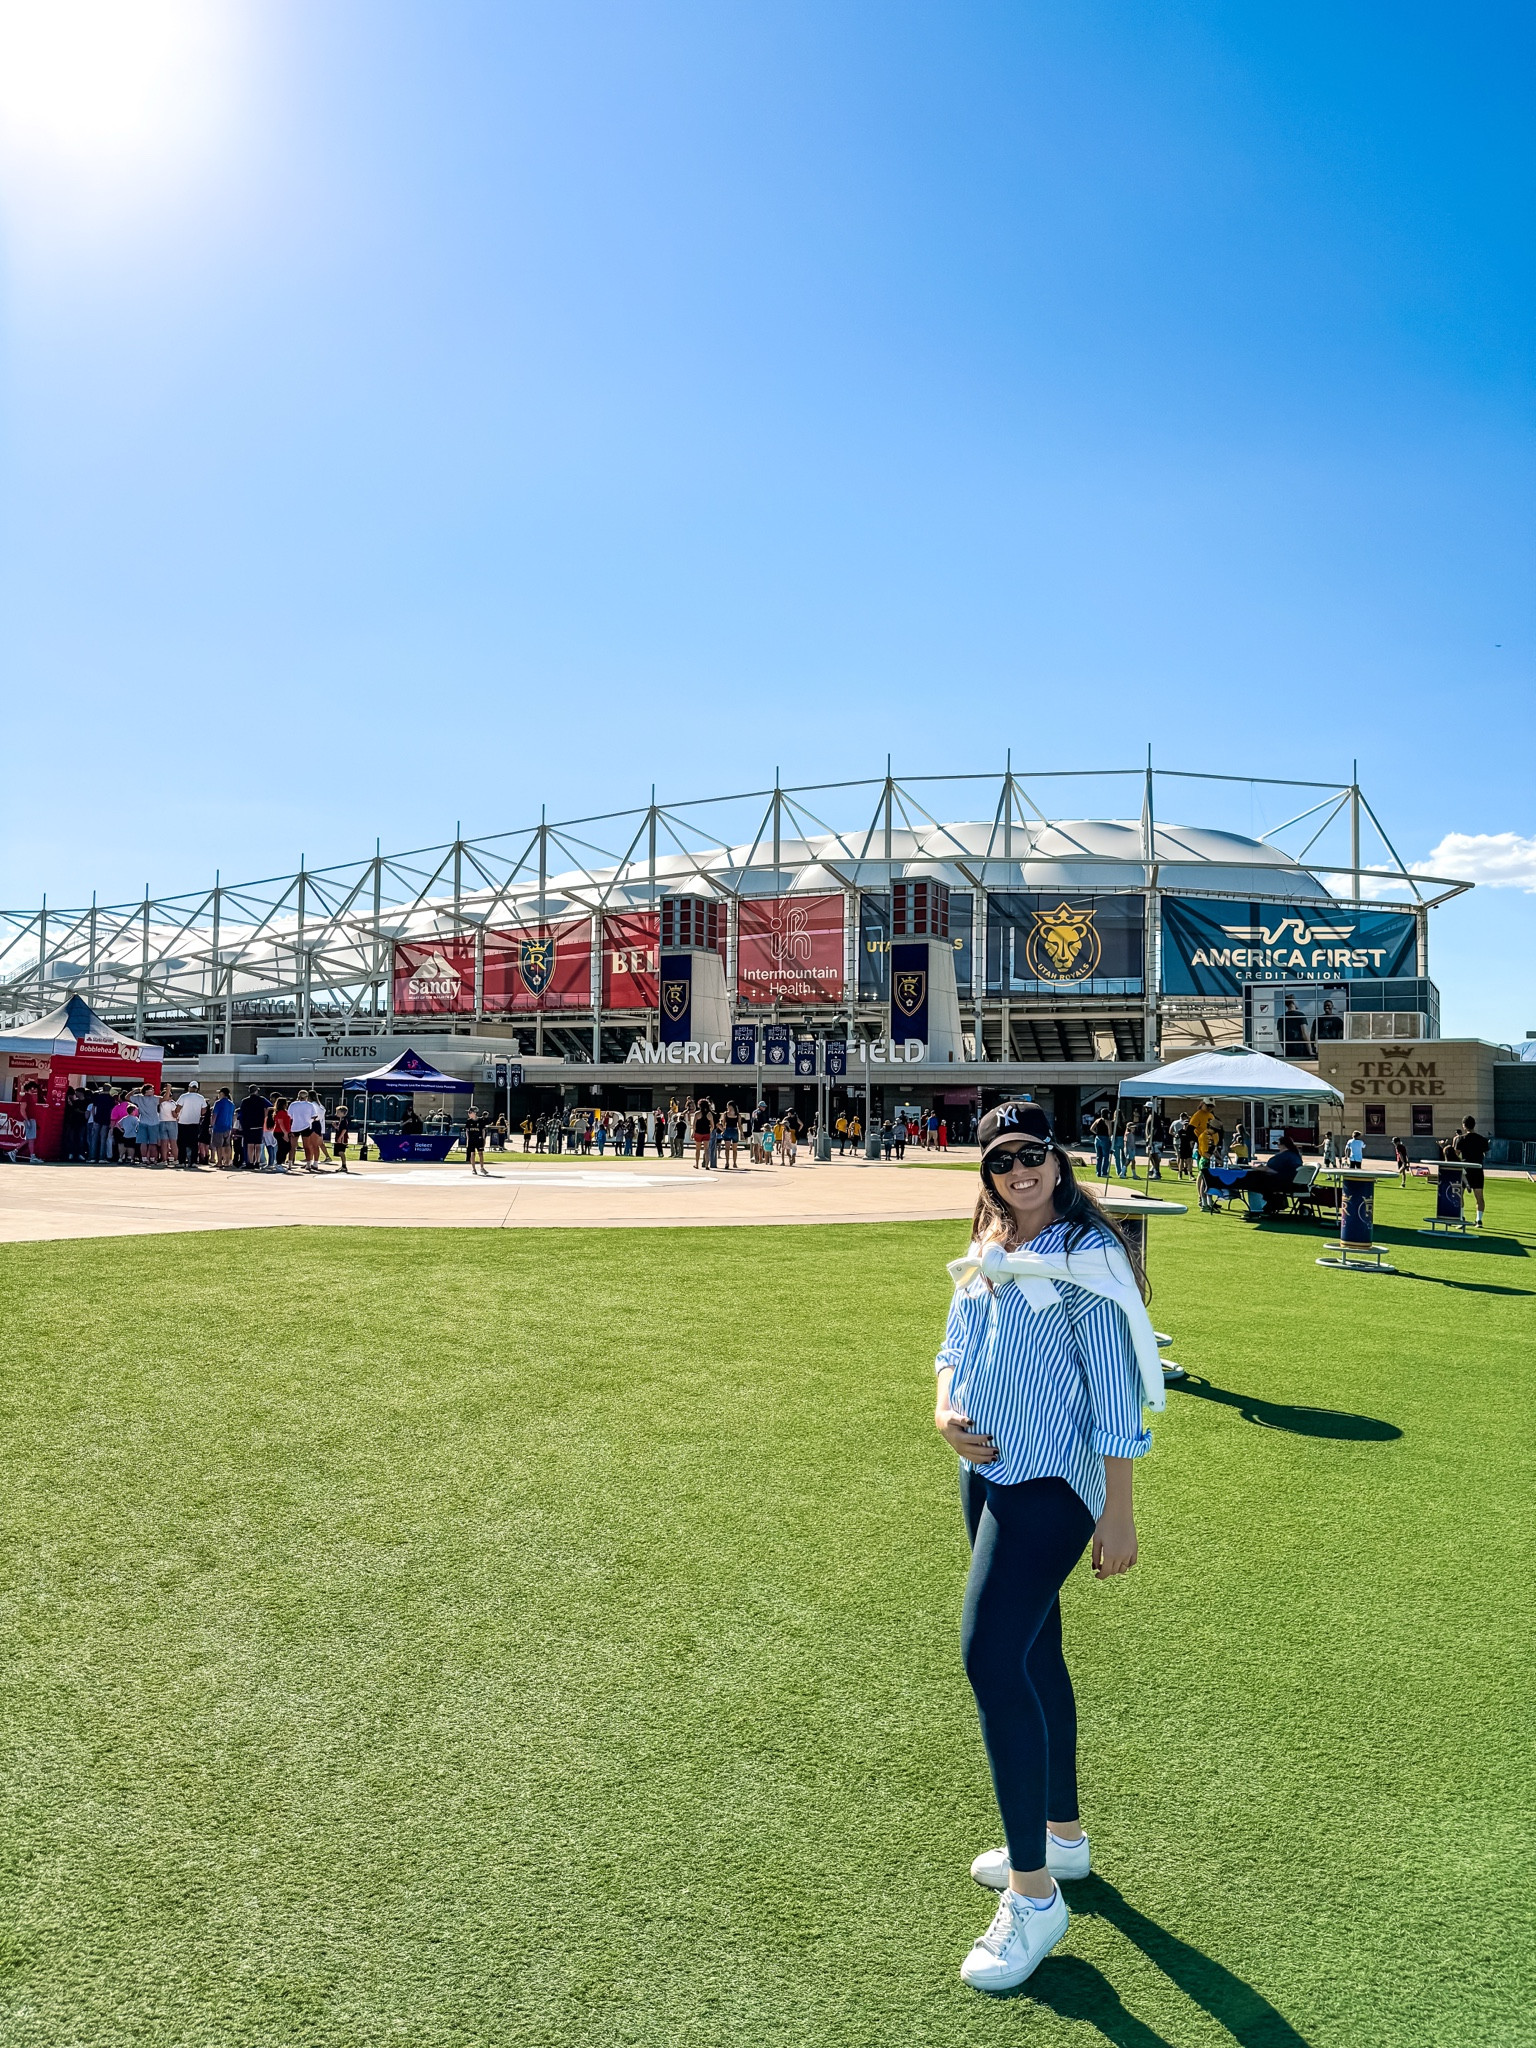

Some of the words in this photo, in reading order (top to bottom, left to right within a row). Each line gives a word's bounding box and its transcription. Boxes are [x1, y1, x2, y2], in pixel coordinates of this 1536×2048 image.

[1191, 949, 1306, 967] AMERICA
[1312, 949, 1387, 967] FIRST
[744, 966, 838, 980] Intermountain
[1038, 963, 1057, 979] UTAH
[1060, 962, 1090, 980] ROYALS
[1235, 971, 1288, 980] CREDIT
[1297, 971, 1341, 980] UNION
[408, 979, 461, 1000] Sandy
[770, 982, 812, 995] Health
[79, 1045, 117, 1054] Bobblehead
[322, 1045, 377, 1057] TICKETS
[625, 1041, 732, 1064] AMERIC
[1358, 1062, 1438, 1078] TEAM
[1350, 1079, 1446, 1096] STORE
